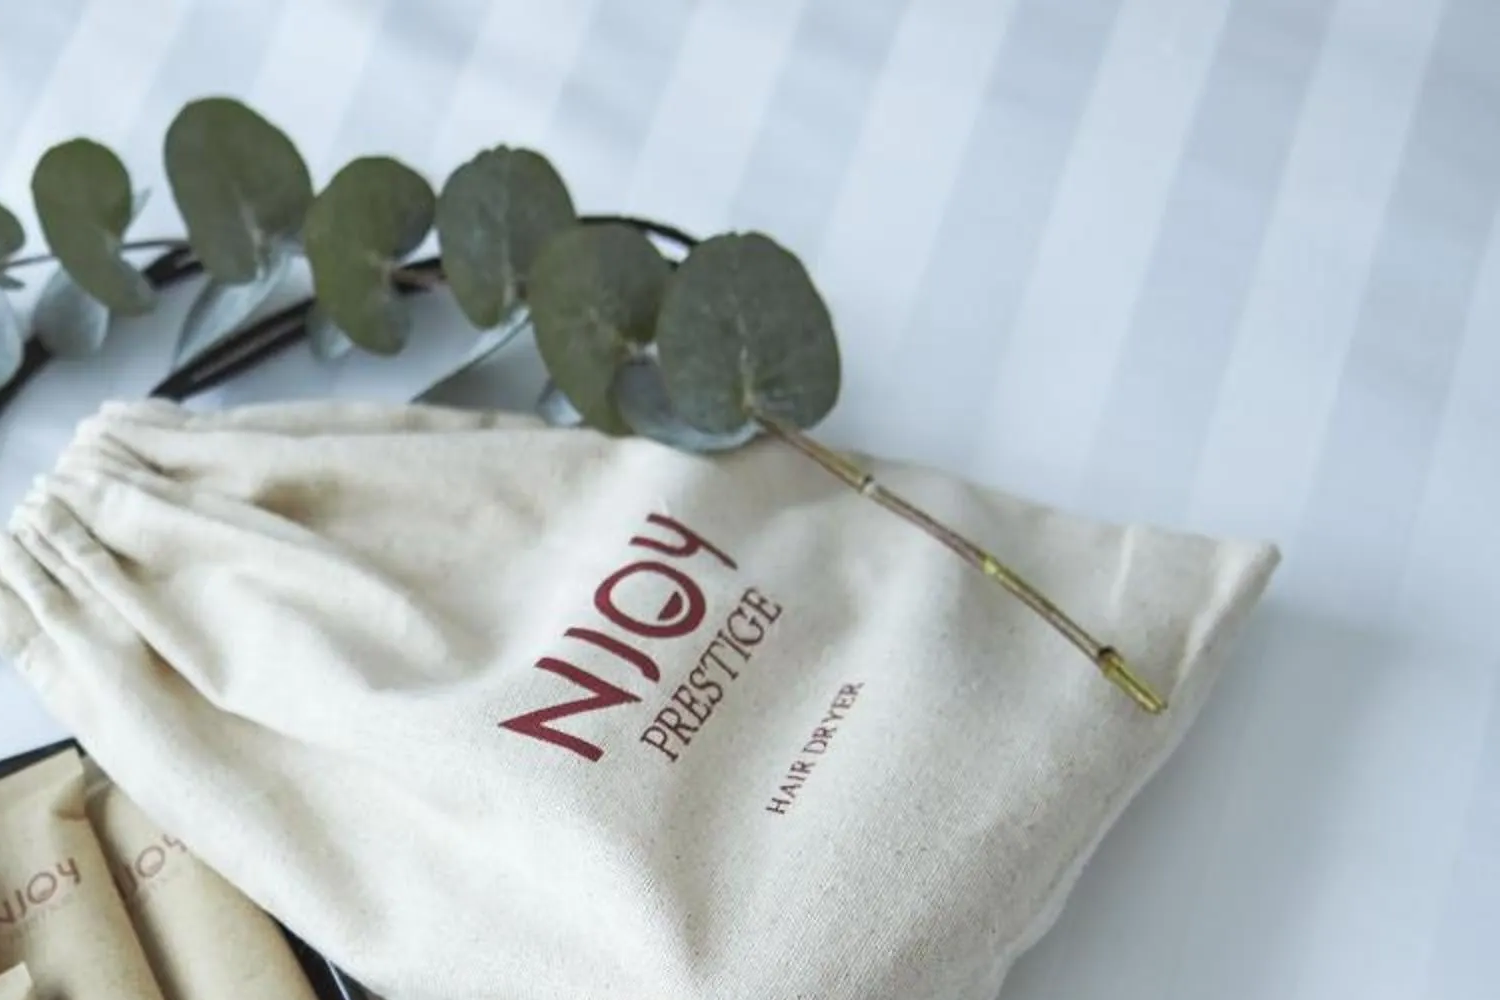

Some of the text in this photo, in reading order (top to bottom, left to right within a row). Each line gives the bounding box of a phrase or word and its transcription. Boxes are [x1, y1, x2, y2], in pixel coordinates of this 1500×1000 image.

[640, 586, 782, 762] PRESTIGE
[765, 682, 865, 814] HAIR DRYER
